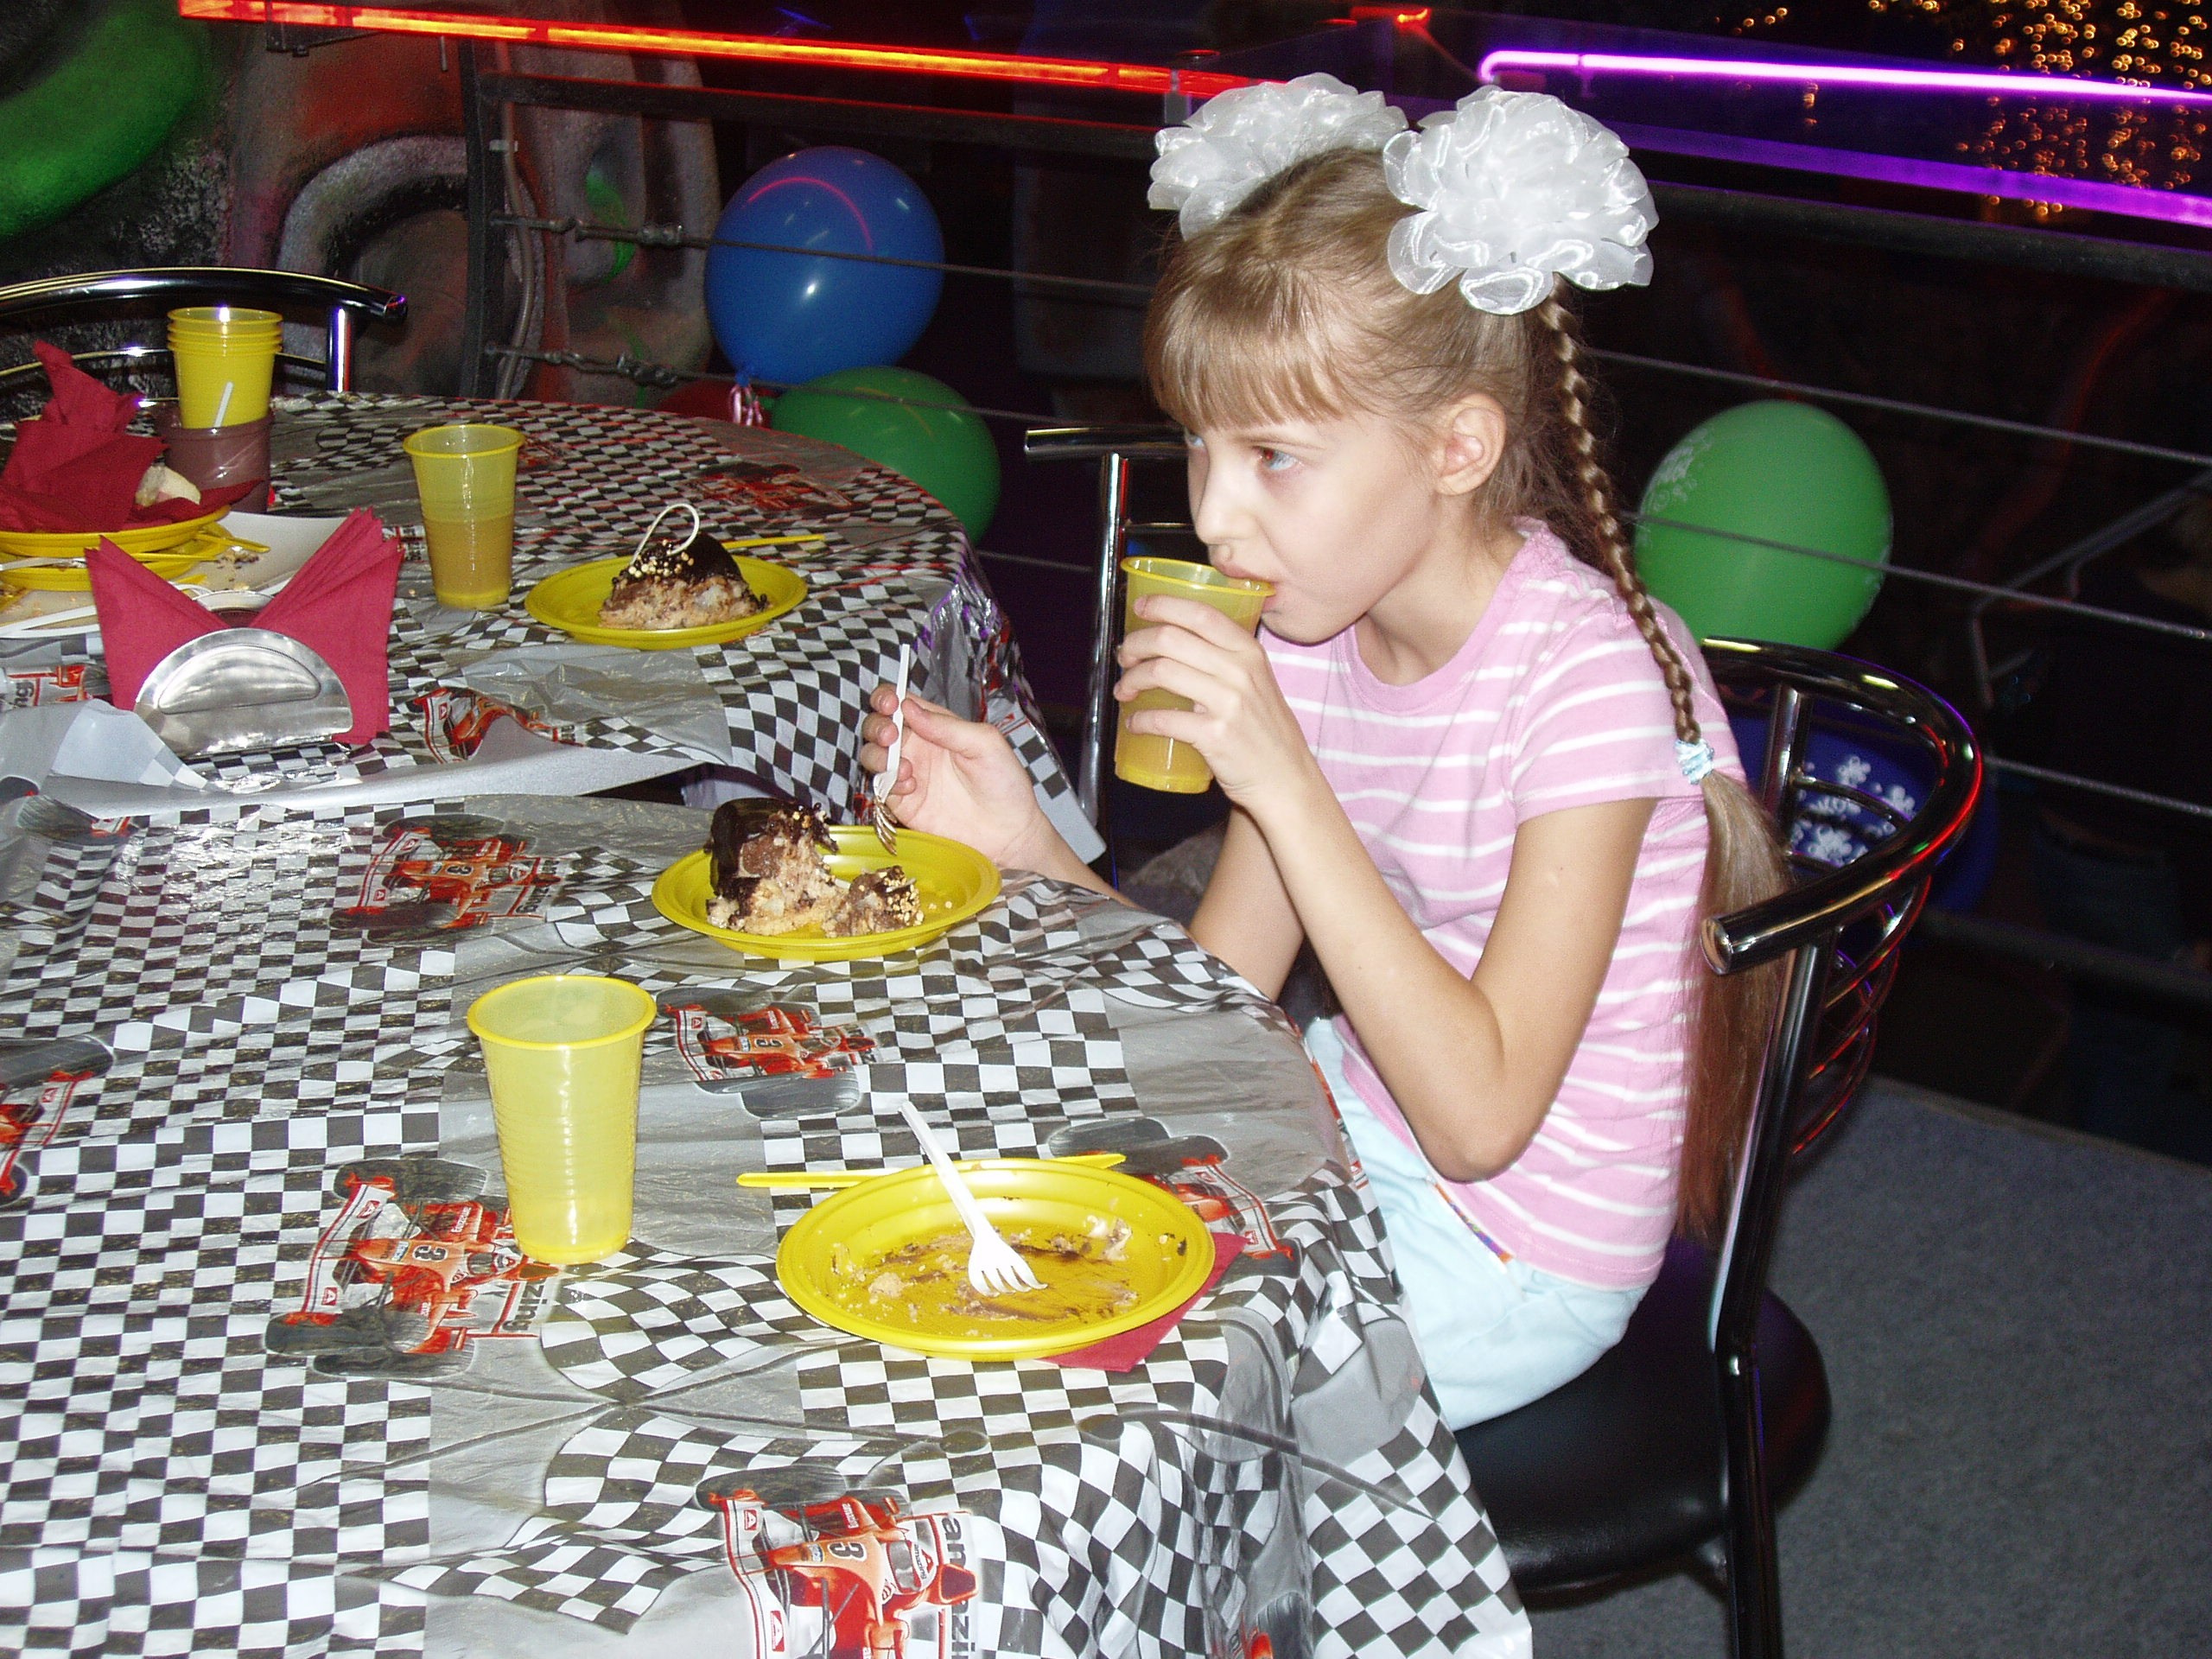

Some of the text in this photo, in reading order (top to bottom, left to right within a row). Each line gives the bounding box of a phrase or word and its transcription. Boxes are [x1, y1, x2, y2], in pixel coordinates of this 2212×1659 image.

[516, 860, 560, 912] amzing
[412, 1244, 448, 1262] 3
[503, 1279, 548, 1332] zing
[830, 1542, 866, 1560] 3
